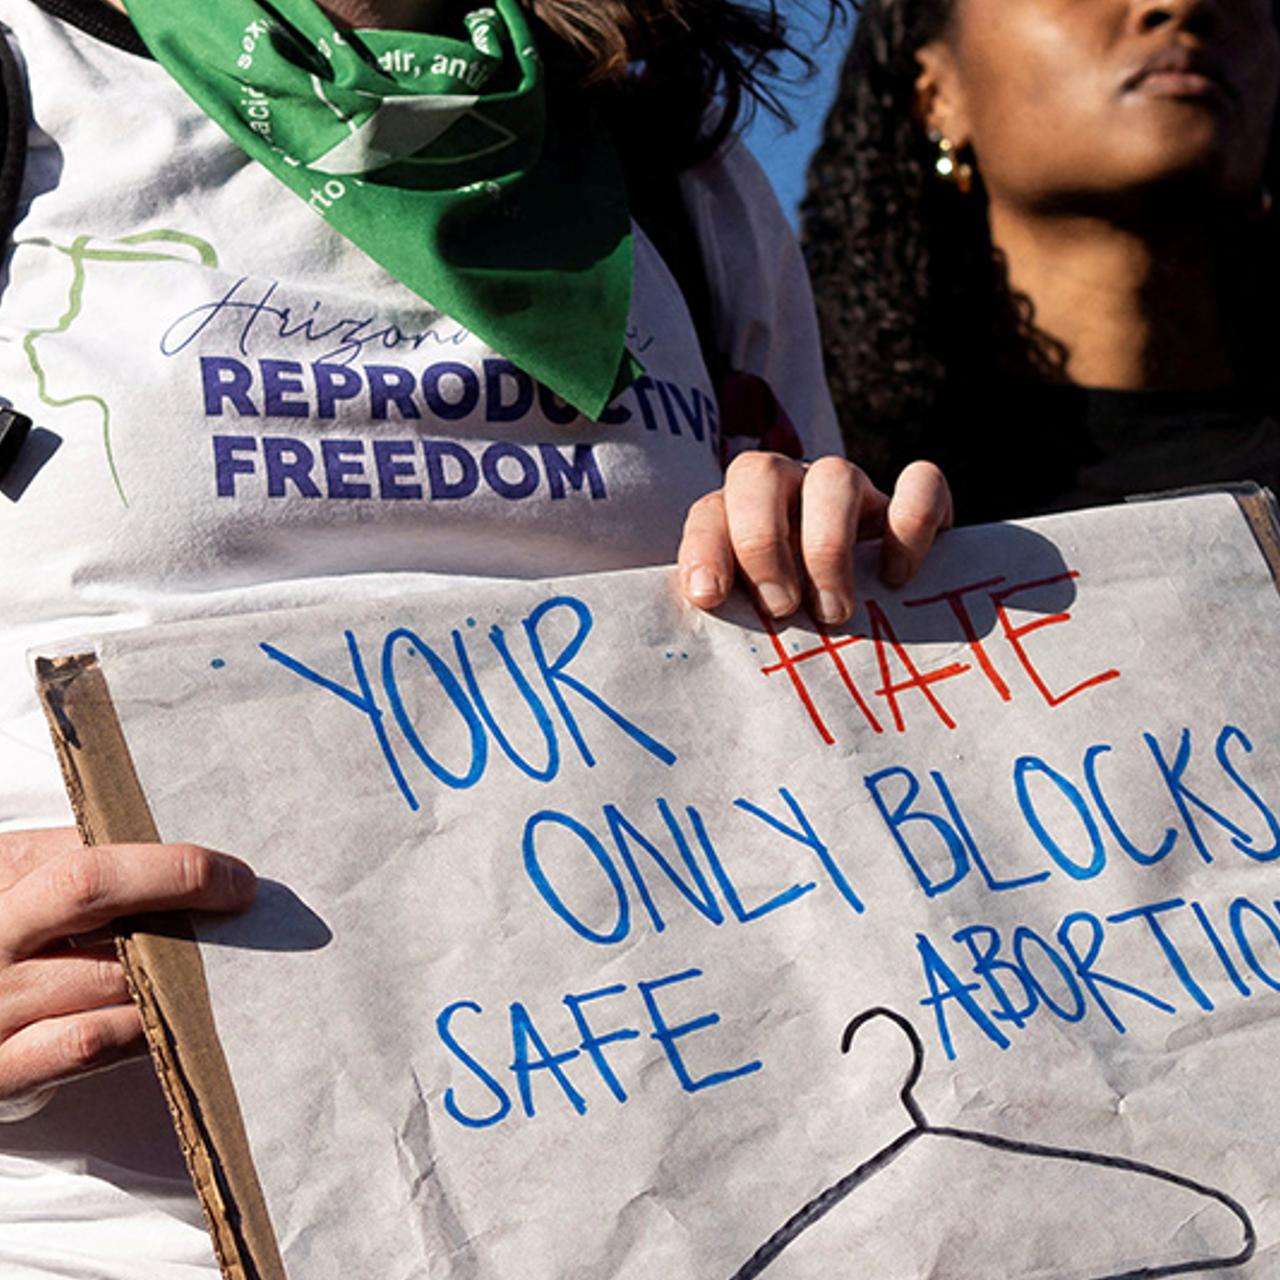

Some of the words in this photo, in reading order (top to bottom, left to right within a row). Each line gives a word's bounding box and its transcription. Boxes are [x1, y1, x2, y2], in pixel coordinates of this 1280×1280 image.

[212, 434, 609, 502] FREEDOM
[260, 596, 677, 810] YOUR
[762, 570, 1120, 746] HATE
[521, 786, 865, 944] ONLY
[438, 968, 763, 1129] SAFE
